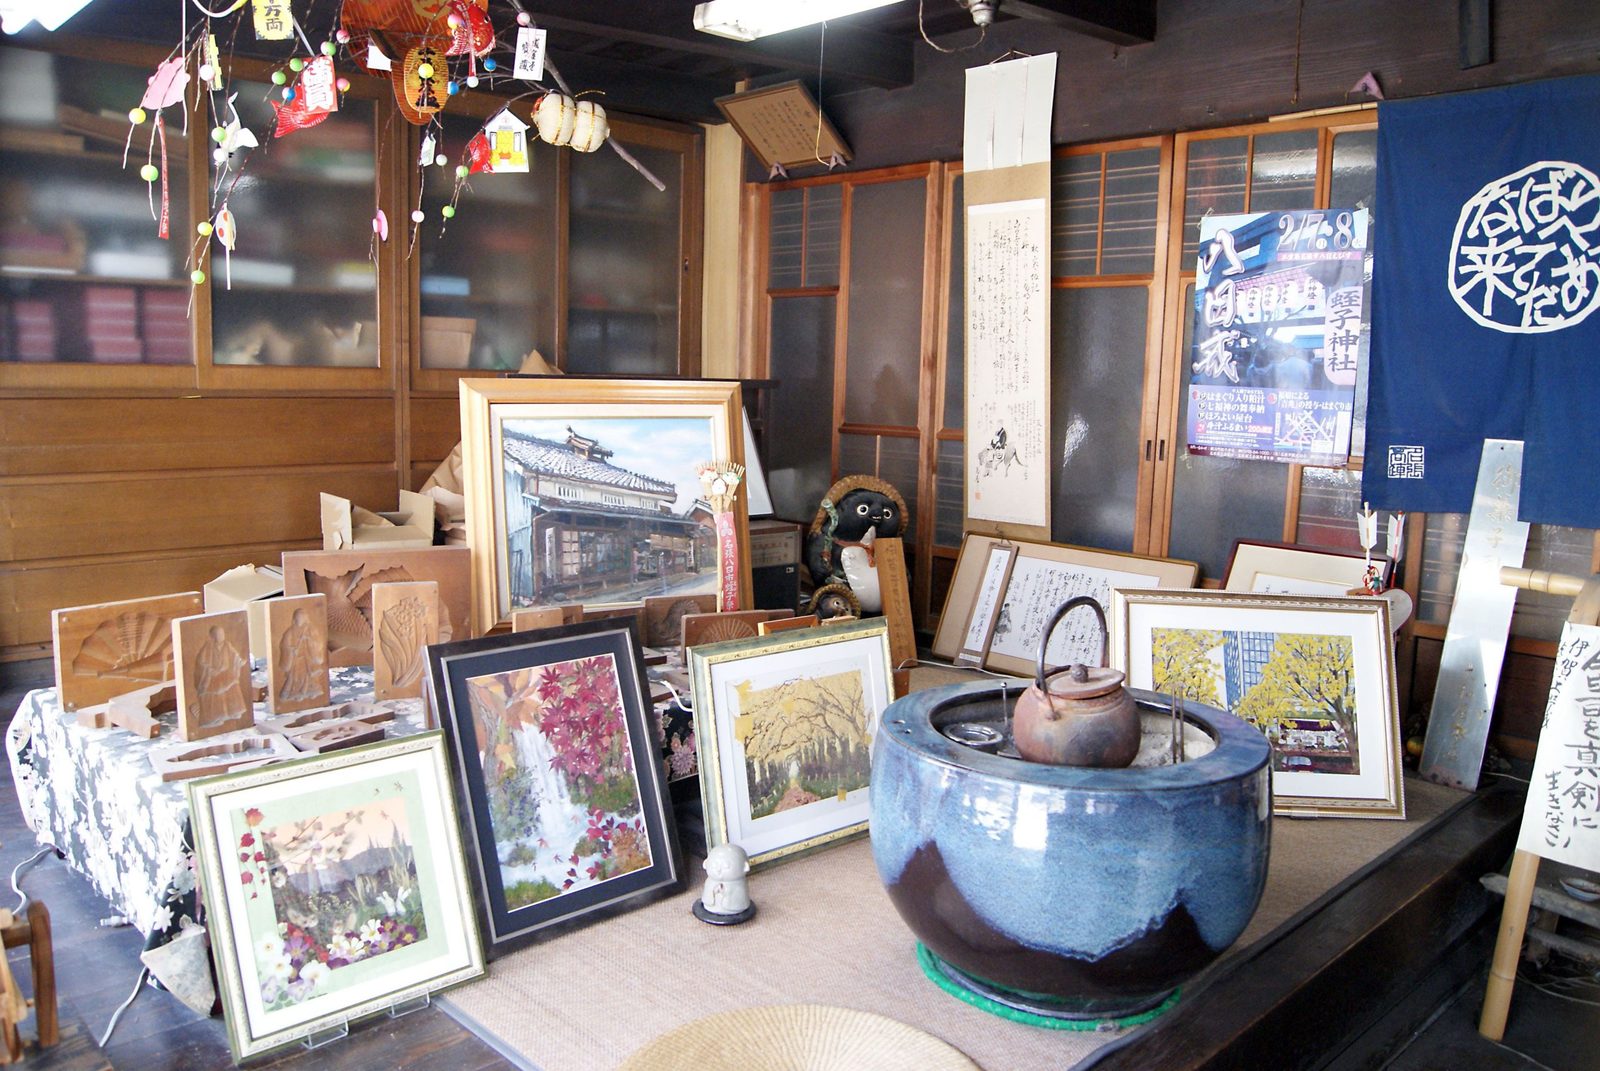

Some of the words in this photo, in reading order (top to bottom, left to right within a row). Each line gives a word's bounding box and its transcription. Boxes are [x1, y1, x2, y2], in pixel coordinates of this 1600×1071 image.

[263, 0, 283, 32] 万両
[1327, 290, 1361, 373] 蛭子神社
